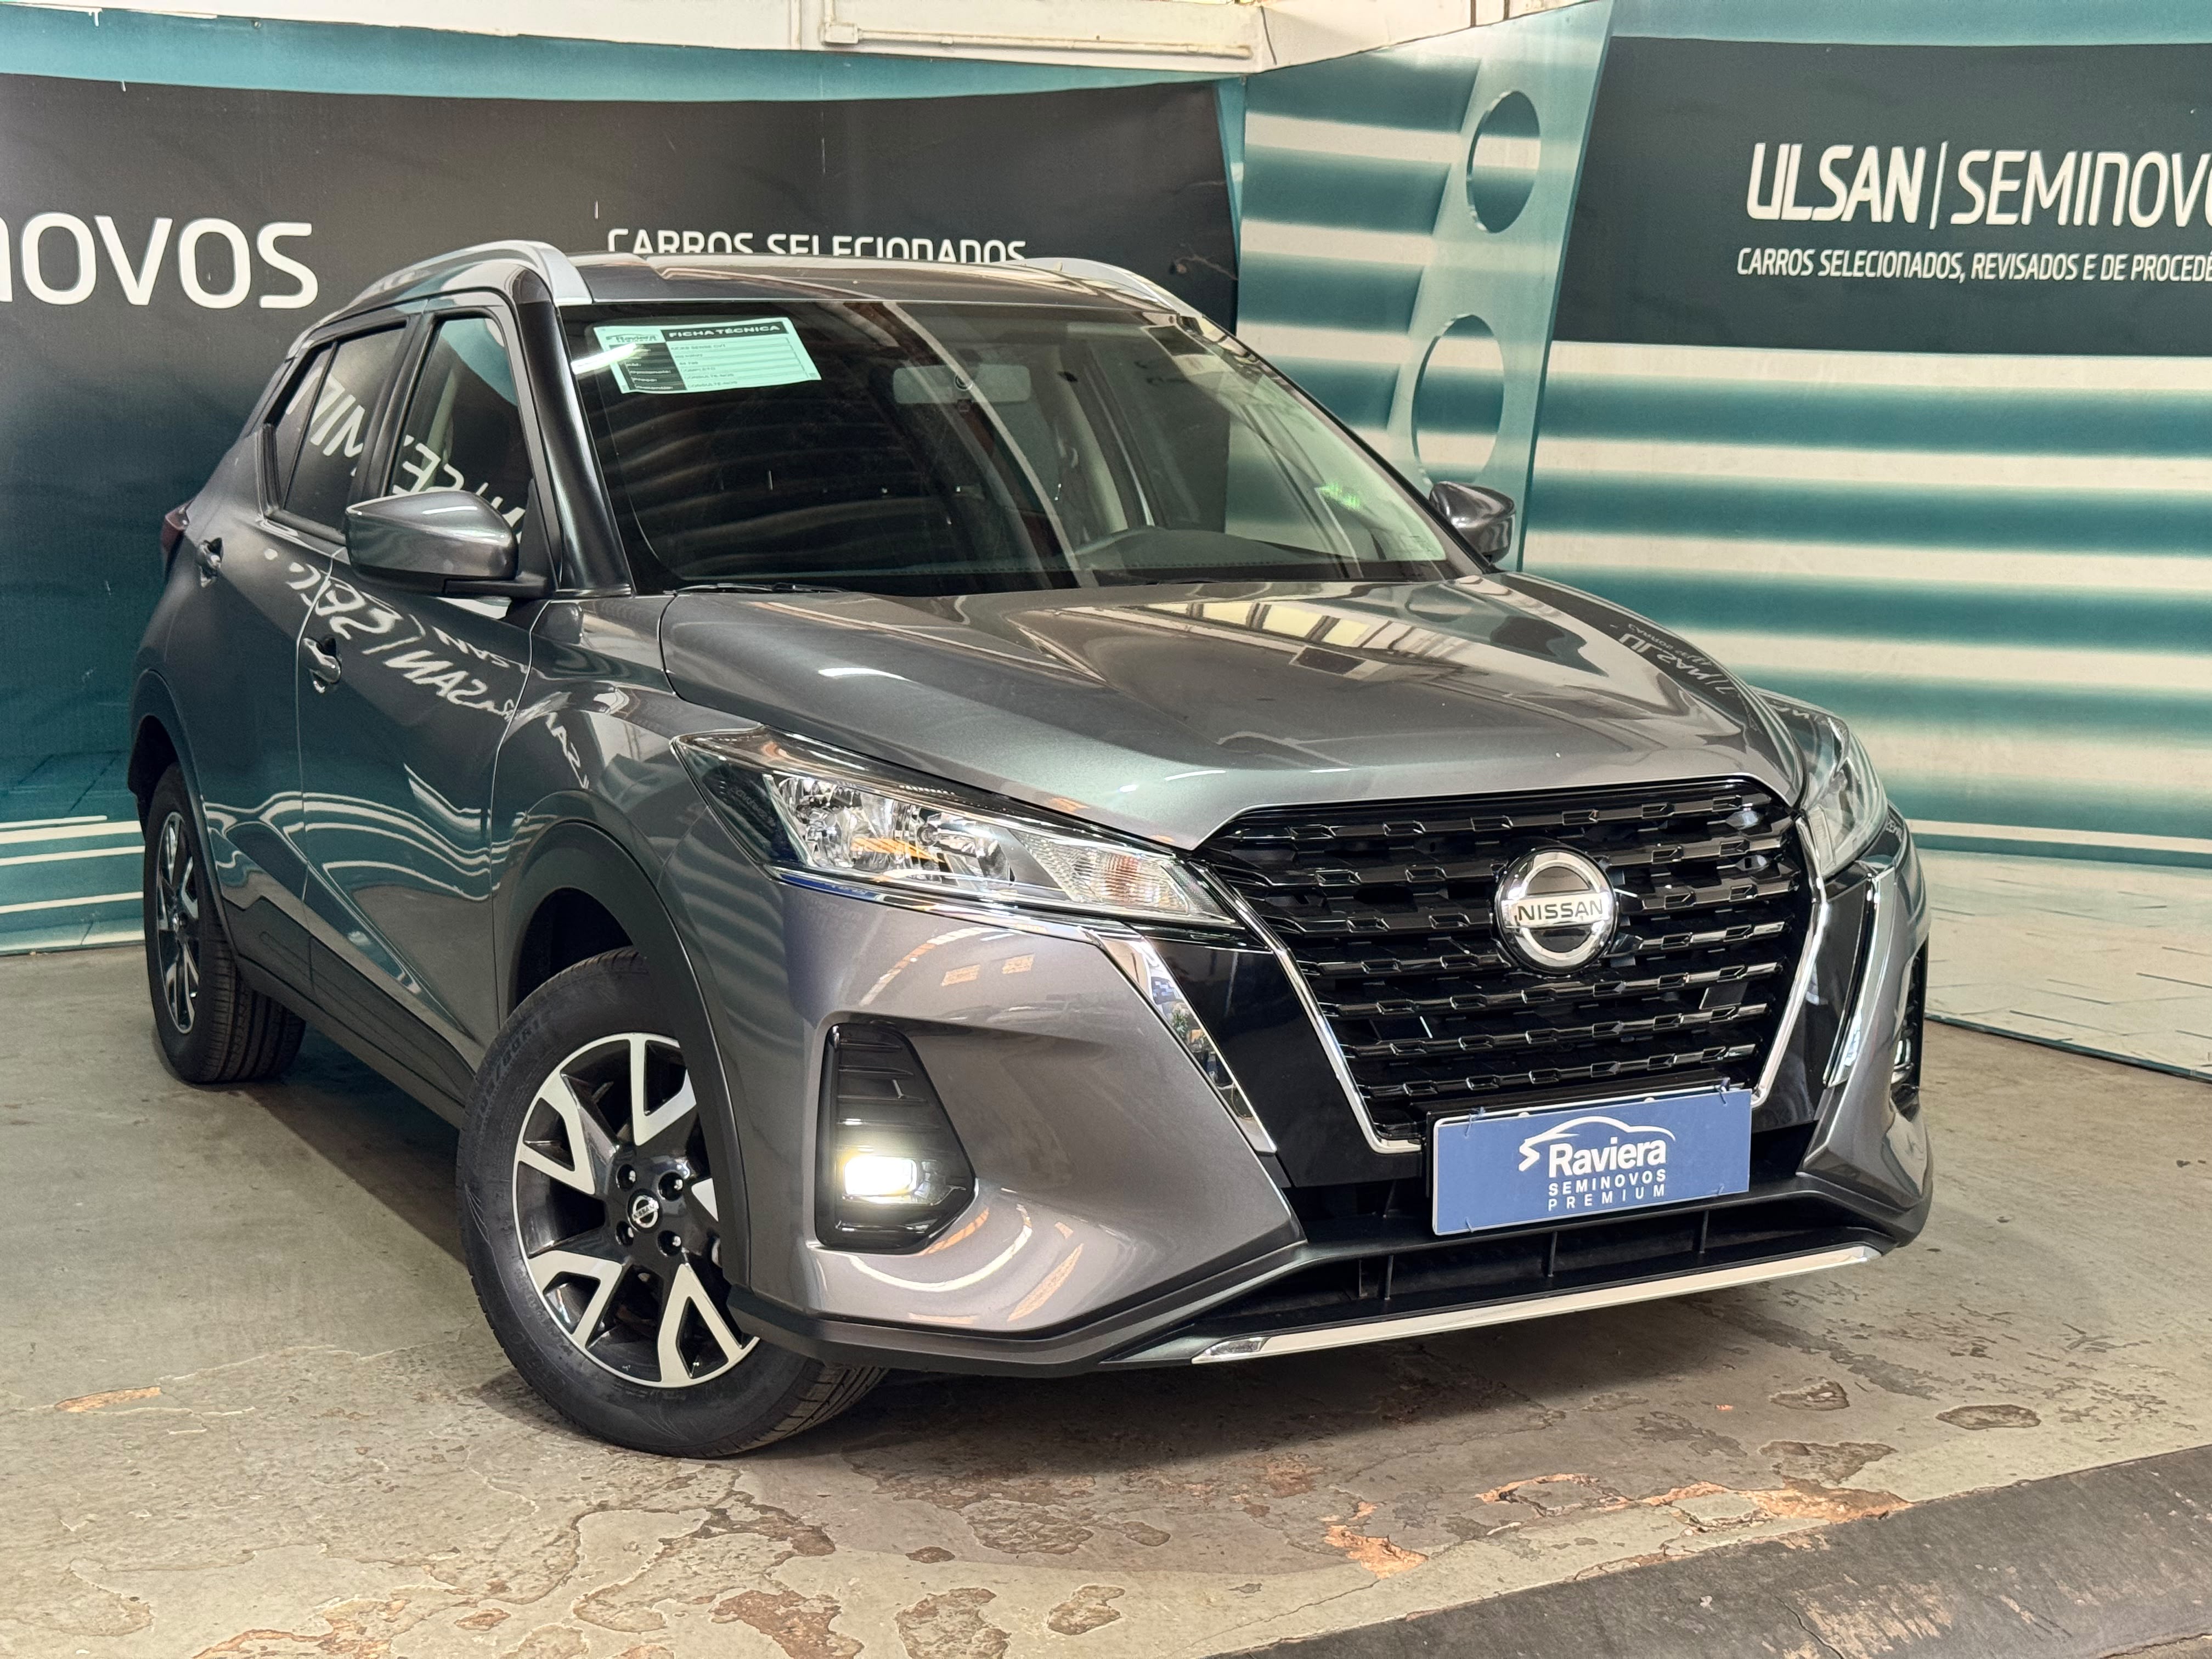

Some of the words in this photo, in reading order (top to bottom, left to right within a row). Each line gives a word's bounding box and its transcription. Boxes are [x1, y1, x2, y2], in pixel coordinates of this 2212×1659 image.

[1747, 142, 1926, 223] ULSAN
[1951, 149, 2212, 228] SEMINOV
[0, 211, 319, 309] OVOS
[1737, 247, 1815, 275] CARROS
[1818, 249, 1964, 284] SELECIONADOS,
[1971, 252, 2081, 281] REVISADOS
[2083, 253, 2098, 281] E
[2101, 254, 2130, 281] DE
[1517, 899, 1603, 921] NISSAN
[1549, 1137, 1666, 1178] Raviera
[1548, 1184, 1664, 1211] PREMIUM
[1549, 1169, 1666, 1197] SEMINOVOS
